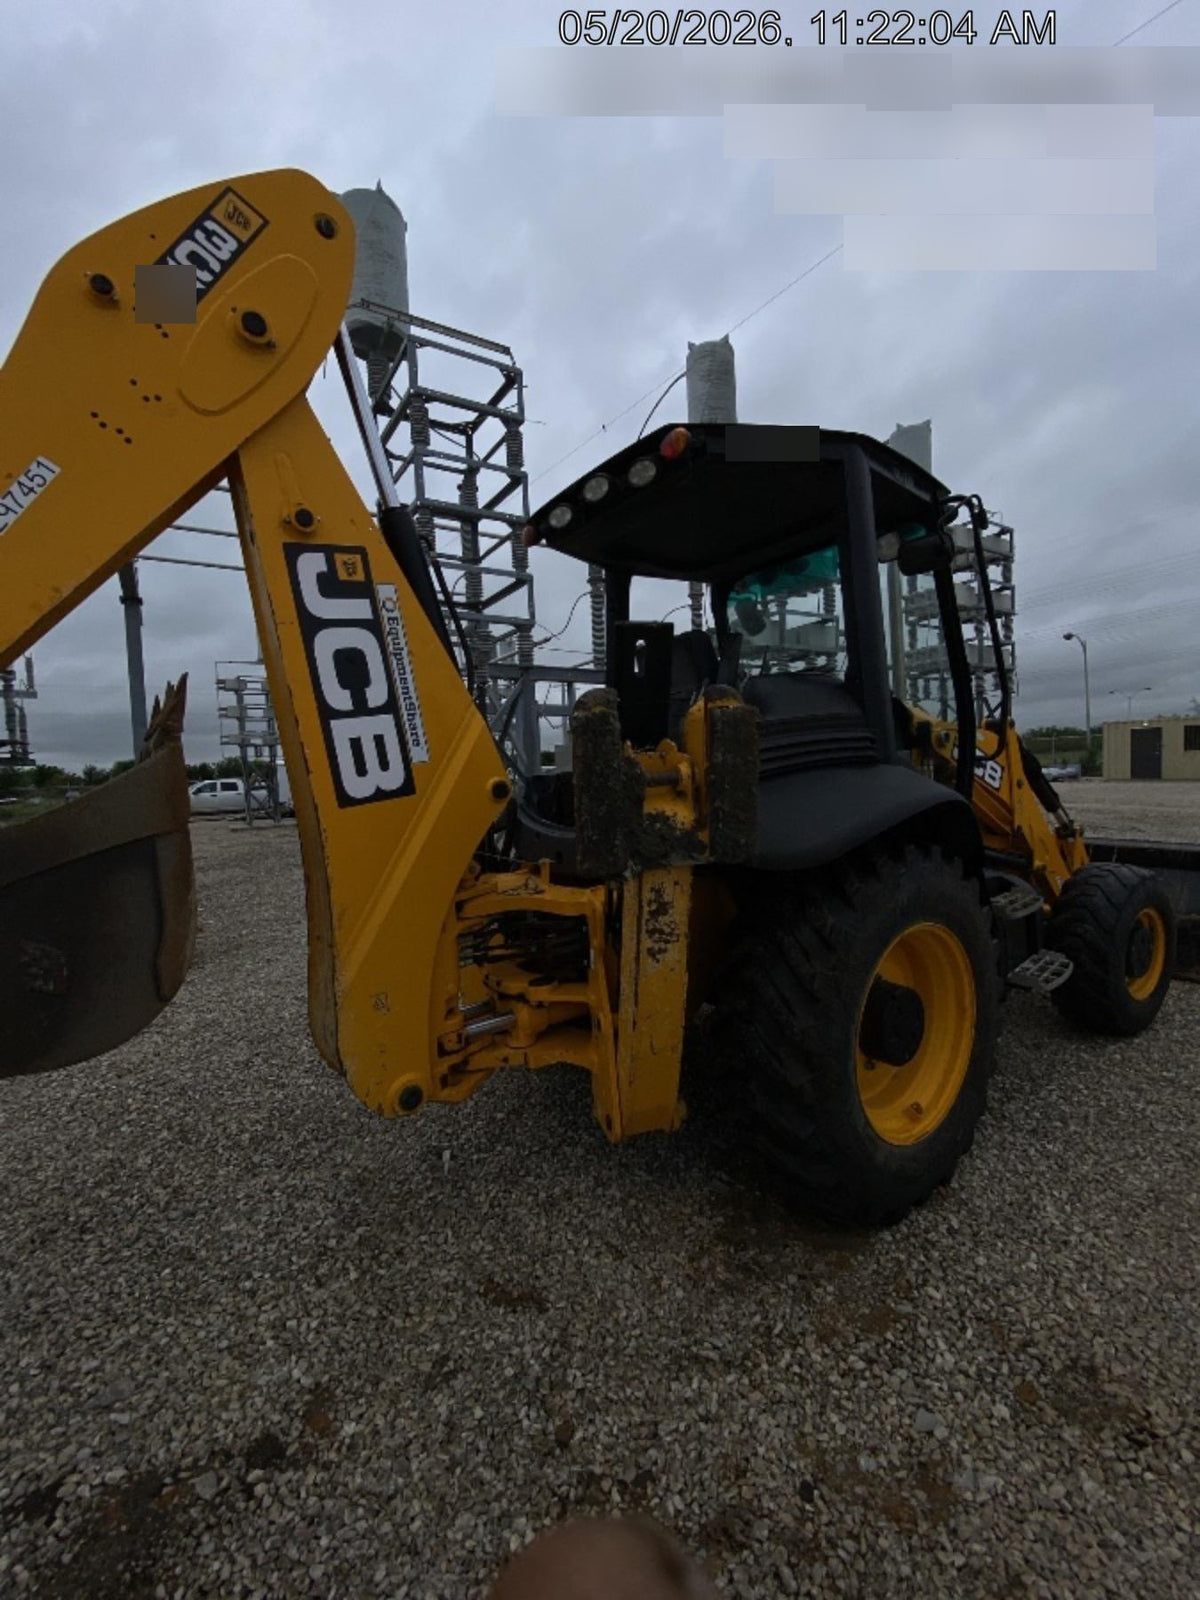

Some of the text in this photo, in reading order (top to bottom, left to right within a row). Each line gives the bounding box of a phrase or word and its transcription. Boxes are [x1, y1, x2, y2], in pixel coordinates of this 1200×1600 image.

[167, 219, 240, 288] 3C
[296, 552, 407, 799] JCB
[385, 615, 421, 748] EquipmentShare
